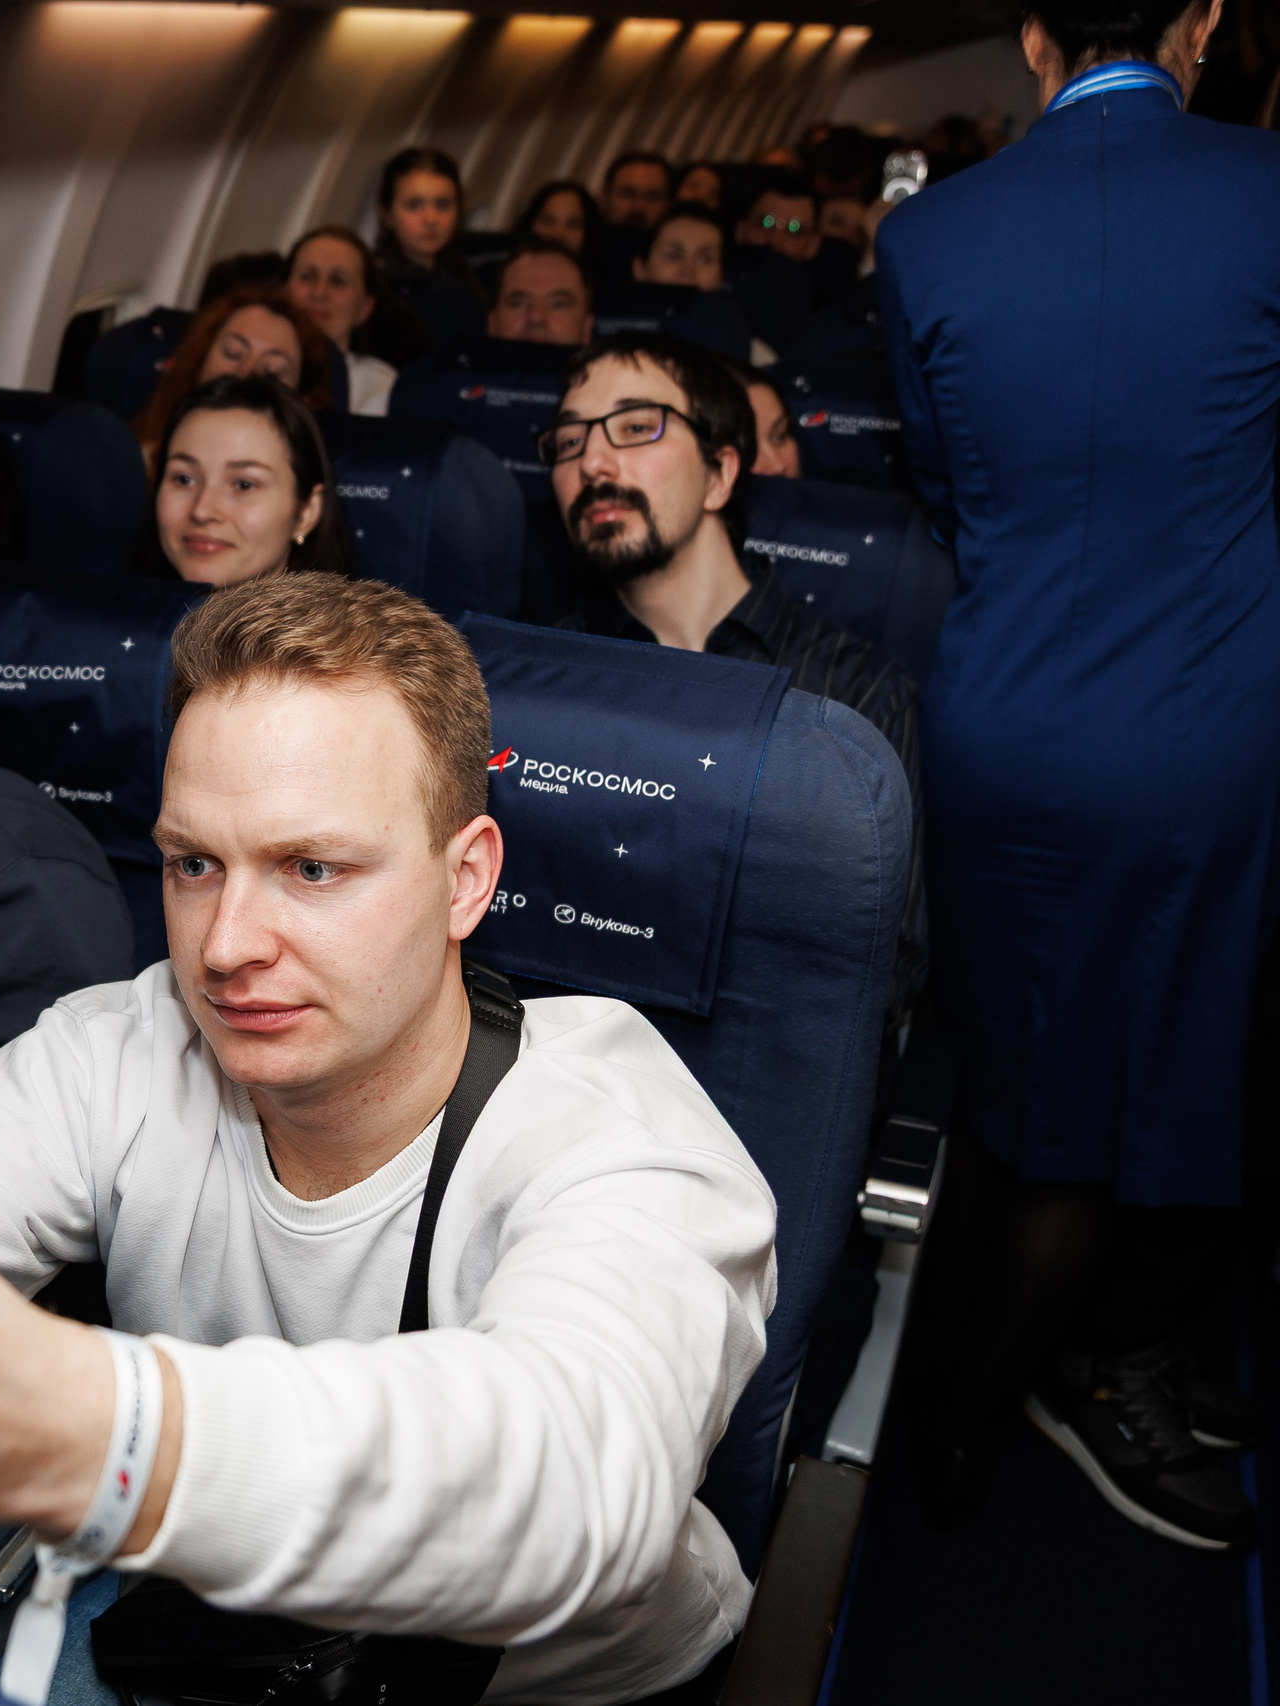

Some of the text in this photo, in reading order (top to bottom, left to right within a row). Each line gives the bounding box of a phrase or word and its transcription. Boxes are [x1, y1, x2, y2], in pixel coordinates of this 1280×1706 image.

[336, 485, 390, 500] ОСМОС
[520, 777, 568, 794] медиа
[523, 758, 676, 800] РОСКОСМОС
[496, 890, 527, 908] RO
[580, 912, 654, 939] Внуково-3
